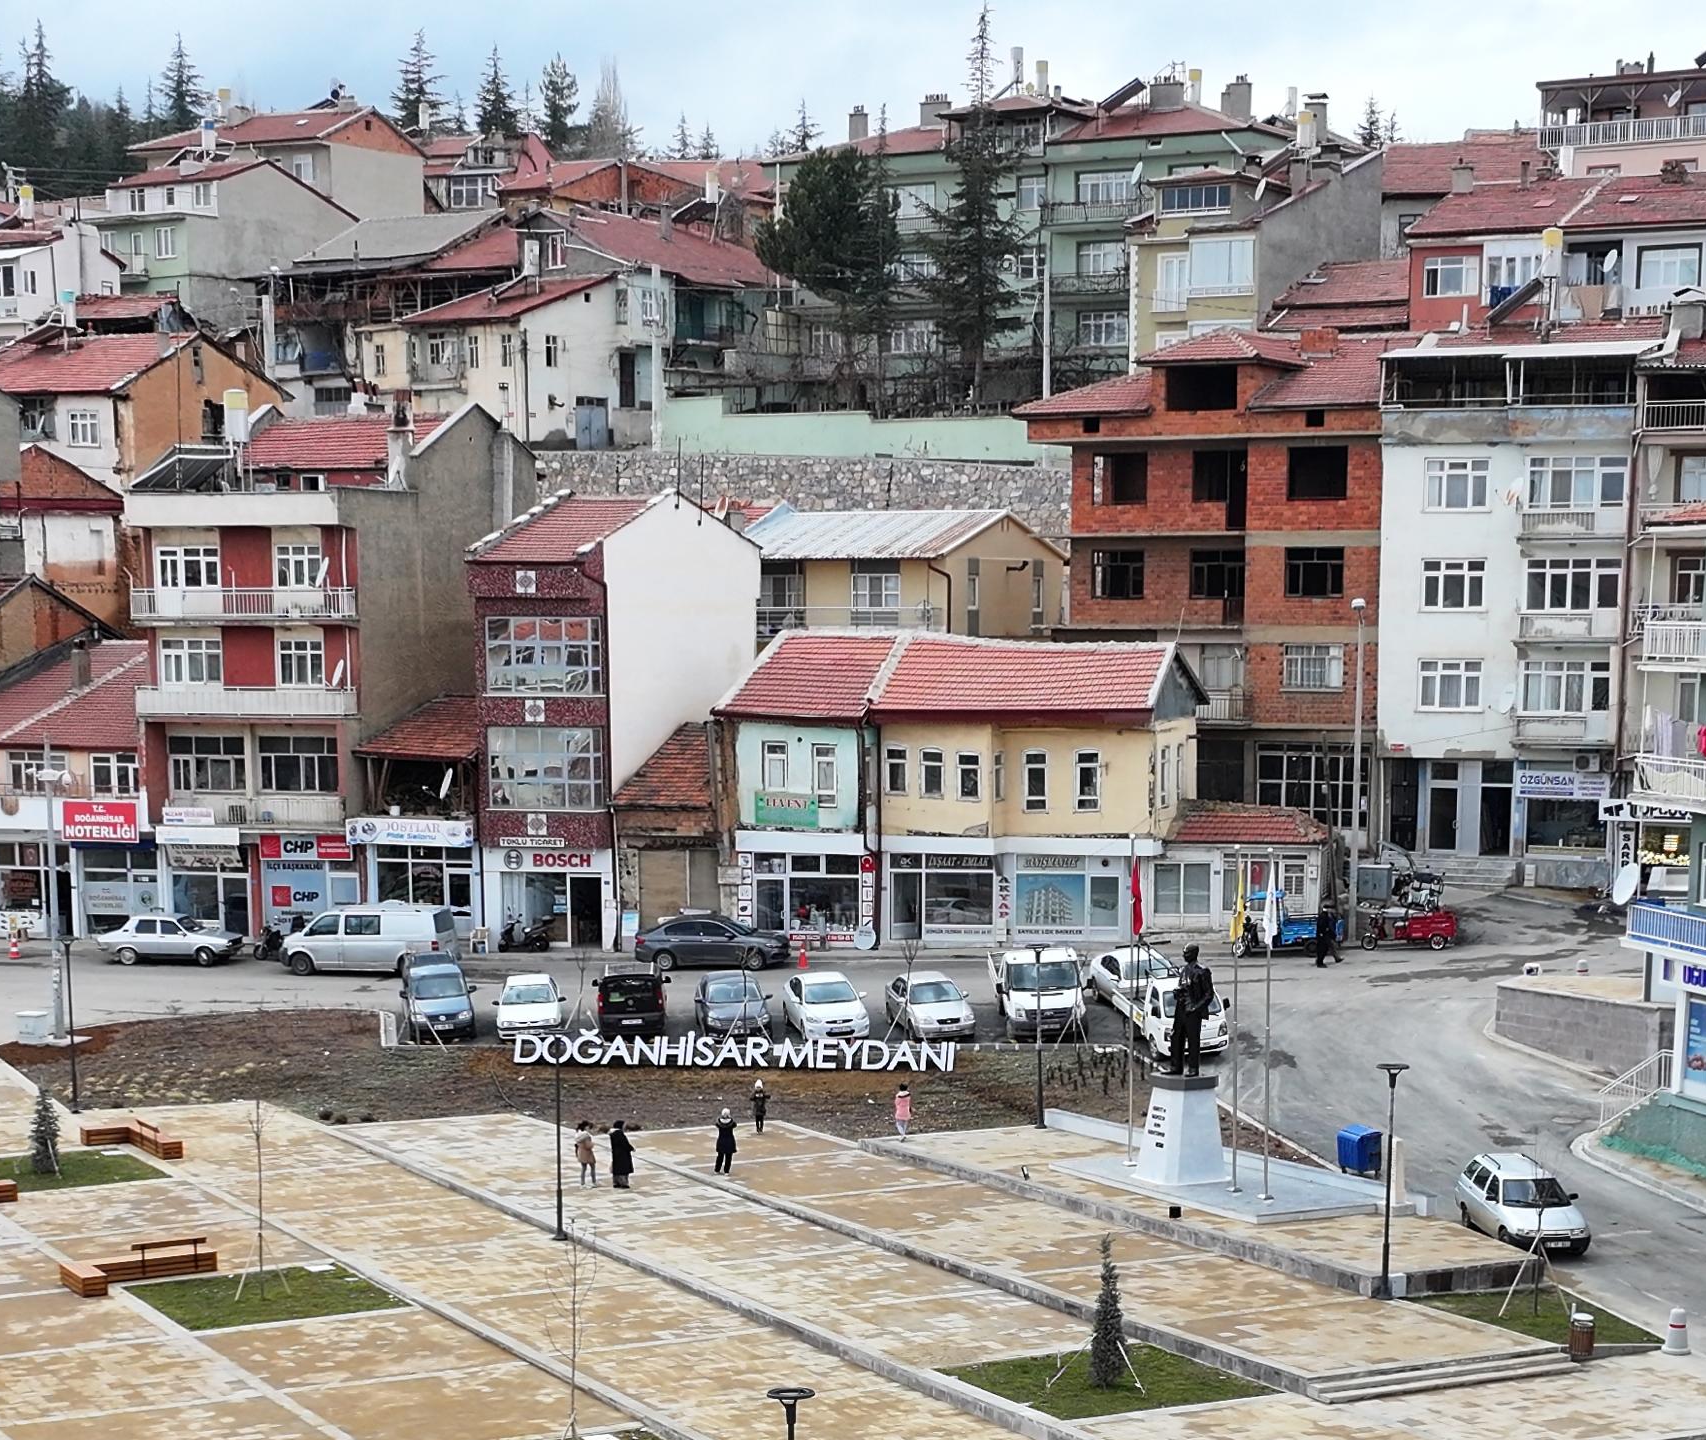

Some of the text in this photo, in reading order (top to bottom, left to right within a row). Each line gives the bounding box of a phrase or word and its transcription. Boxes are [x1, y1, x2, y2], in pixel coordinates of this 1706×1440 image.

[1520, 772, 1574, 786] ÖZGÜNSAN
[74, 813, 124, 824] DOĞANHİSAR
[65, 823, 135, 839] NOTERLİĞİ
[283, 840, 314, 853] CHP
[532, 853, 591, 867] BOSCH
[961, 856, 990, 866] EMLAK
[293, 891, 319, 902] CHP
[998, 876, 1011, 919] AKYAP
[513, 1028, 956, 1072] DOĞANHİSAR MEYDANI
